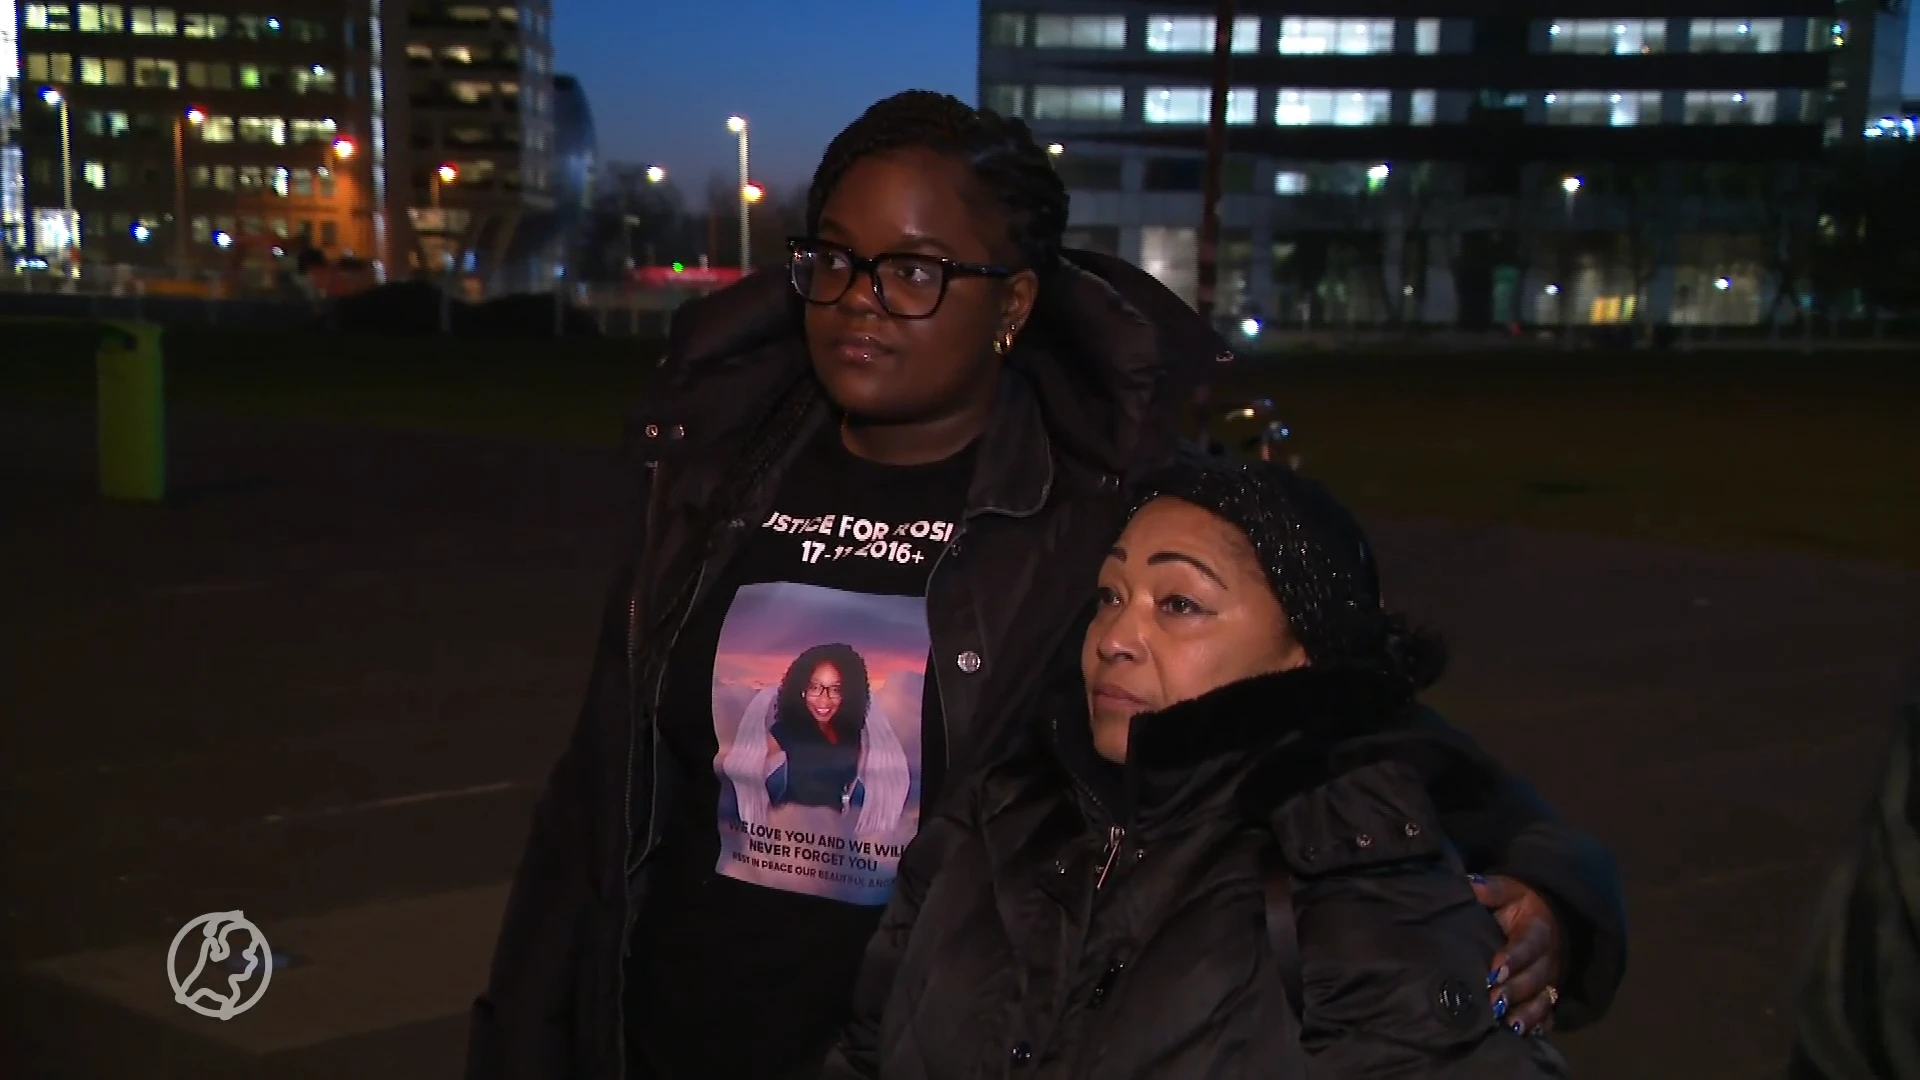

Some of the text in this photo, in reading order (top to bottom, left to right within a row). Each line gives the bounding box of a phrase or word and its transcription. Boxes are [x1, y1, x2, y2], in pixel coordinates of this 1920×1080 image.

[838, 514, 890, 542] FOR
[750, 823, 782, 841] LOVE
[785, 830, 815, 845] YOU
[818, 834, 845, 850] AND
[848, 839, 871, 855] WE
[732, 851, 750, 864] REST
[751, 857, 760, 868] IN
[761, 859, 793, 874] PEACE
[794, 866, 816, 878] OUR
[749, 838, 878, 872] NEVER FORGET YOU
